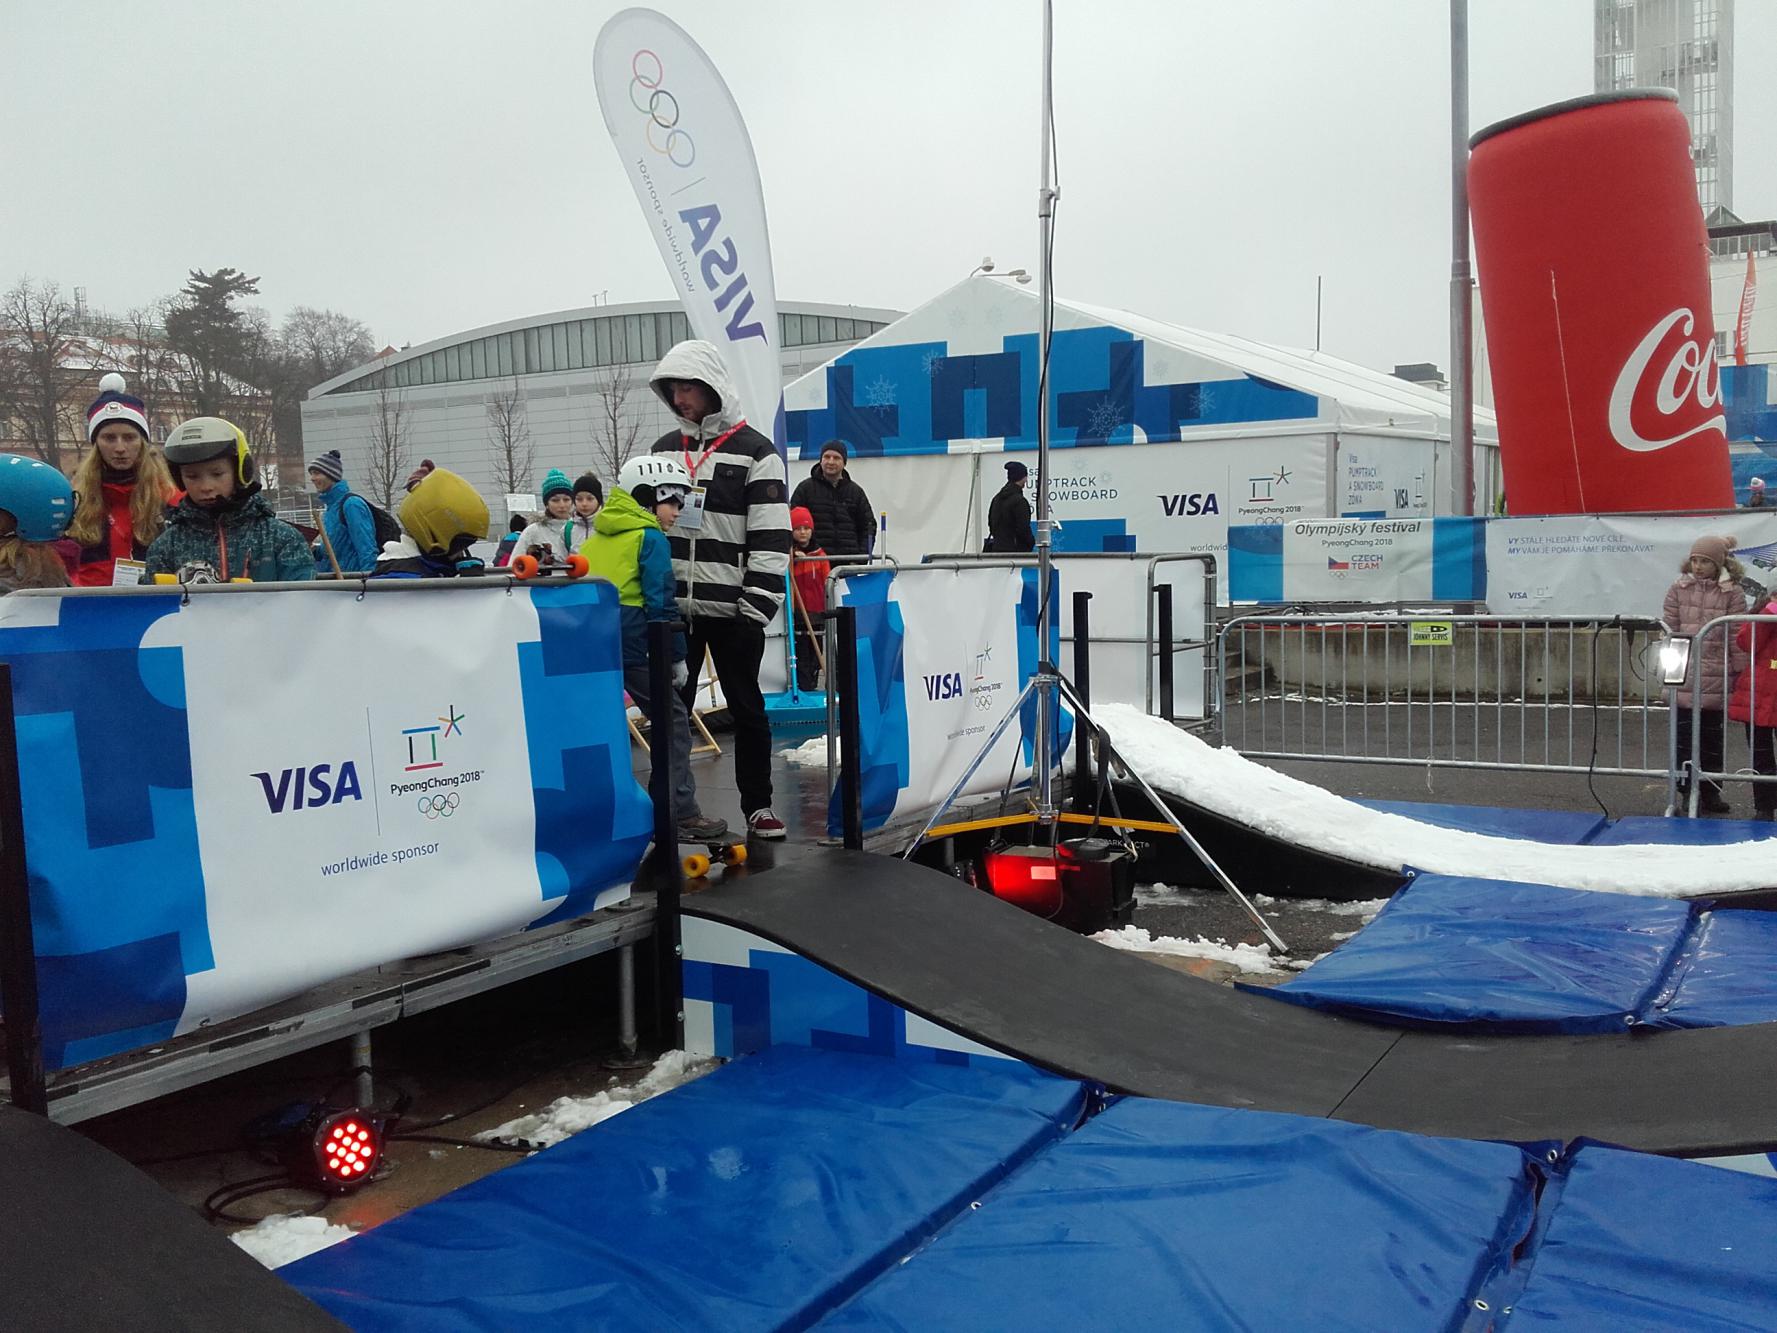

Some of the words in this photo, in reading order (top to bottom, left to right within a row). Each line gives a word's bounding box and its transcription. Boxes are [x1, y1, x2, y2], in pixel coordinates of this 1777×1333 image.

[1031, 488, 1118, 502] SOWBOARD
[1156, 492, 1219, 517] VISA
[1238, 506, 1285, 515] PyeongChang
[1294, 522, 1367, 536] Olympijský
[1370, 521, 1421, 534] festival
[1190, 542, 1229, 552] worldwid
[1321, 539, 1374, 548] PyeongChang
[1374, 538, 1393, 546] 2018
[1351, 554, 1384, 562] CZECH
[1351, 562, 1380, 570] TEAM
[922, 672, 963, 701] VISA
[249, 760, 362, 815] VISA
[390, 775, 459, 797] PyeongChang
[320, 850, 389, 876] worldwide
[391, 841, 440, 862] sponsor
